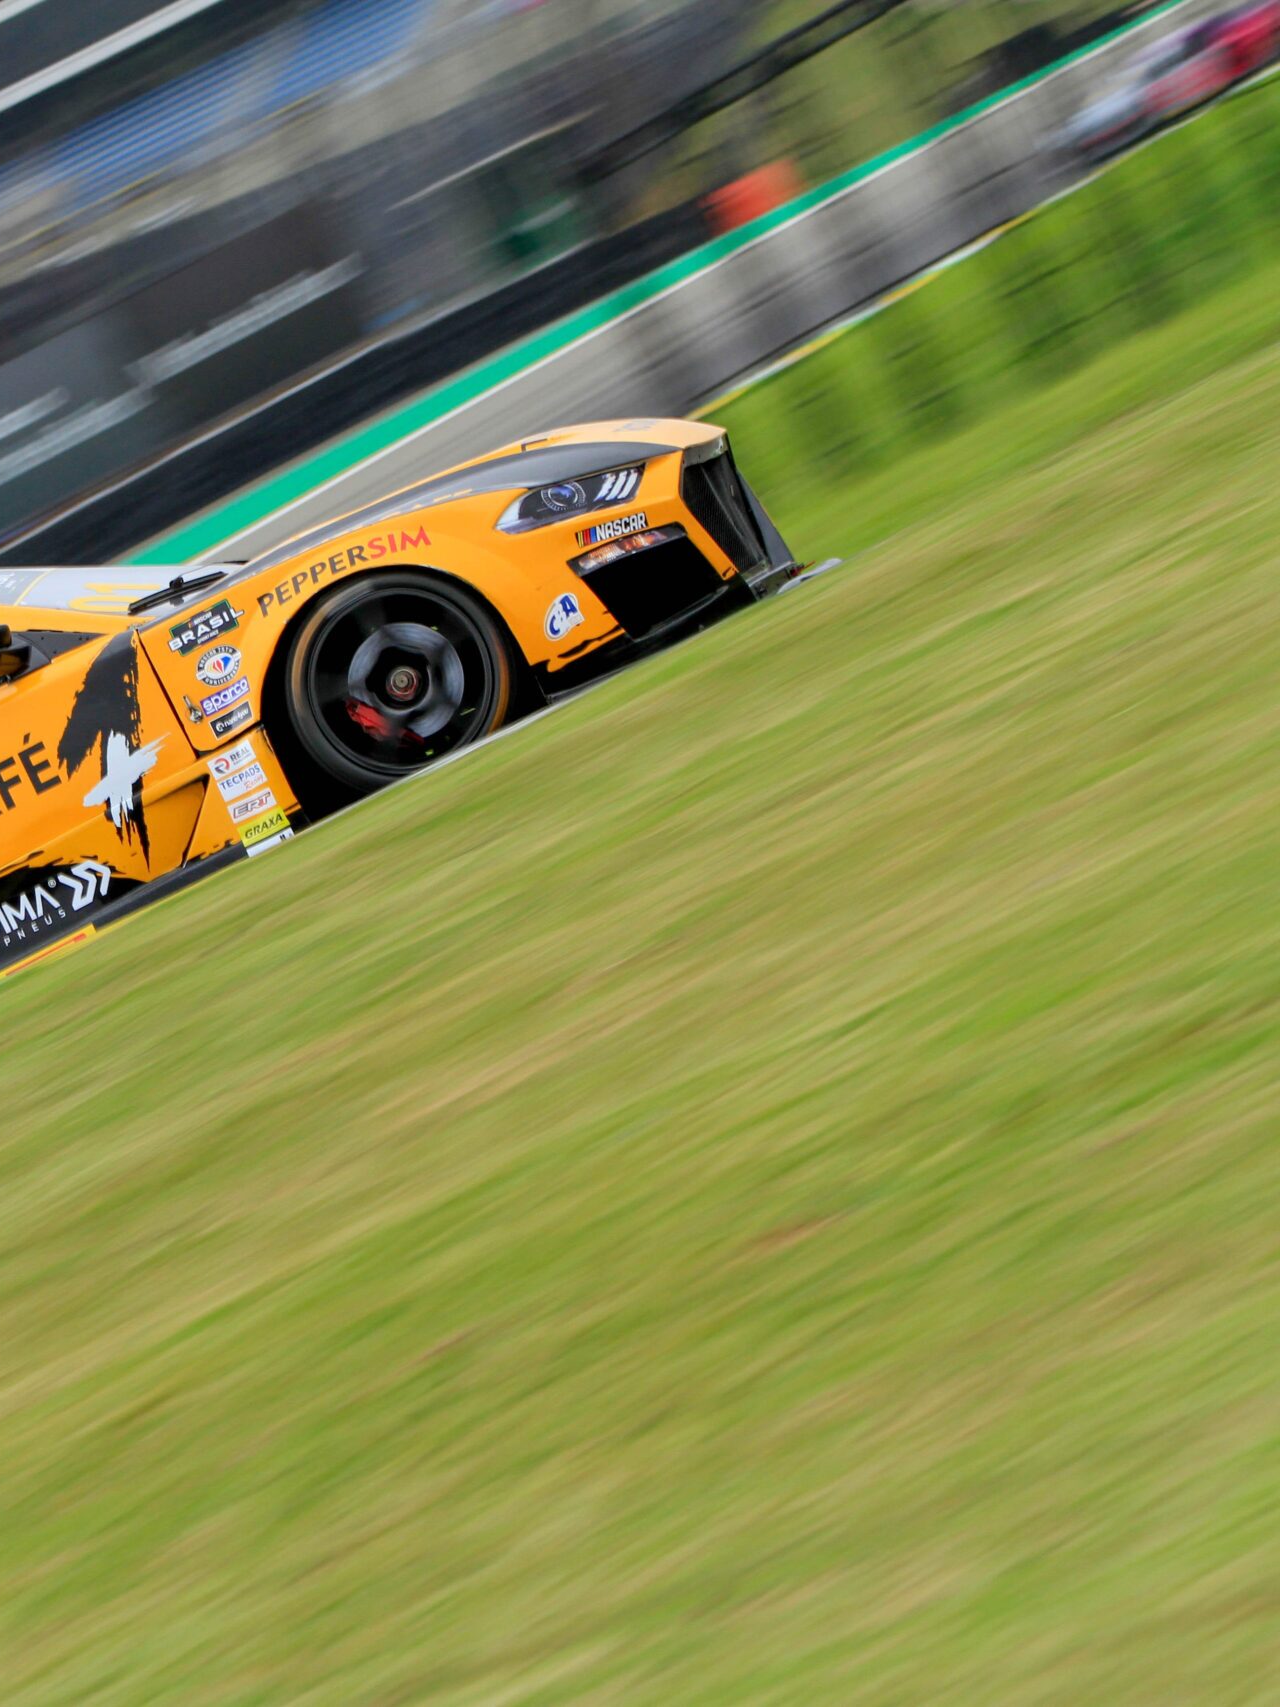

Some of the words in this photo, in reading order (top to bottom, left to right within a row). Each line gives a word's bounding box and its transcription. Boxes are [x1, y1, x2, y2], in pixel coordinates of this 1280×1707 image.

[596, 512, 647, 541] NASCAR
[257, 526, 431, 617] PEPPERSIM
[168, 608, 244, 651] BRASIL
[548, 595, 577, 635] CBA
[203, 678, 249, 713] sparco
[230, 745, 250, 762] REAL
[220, 763, 261, 791] TECPADS
[244, 814, 284, 839] GRAXA
[4, 908, 66, 947] PNEUS
